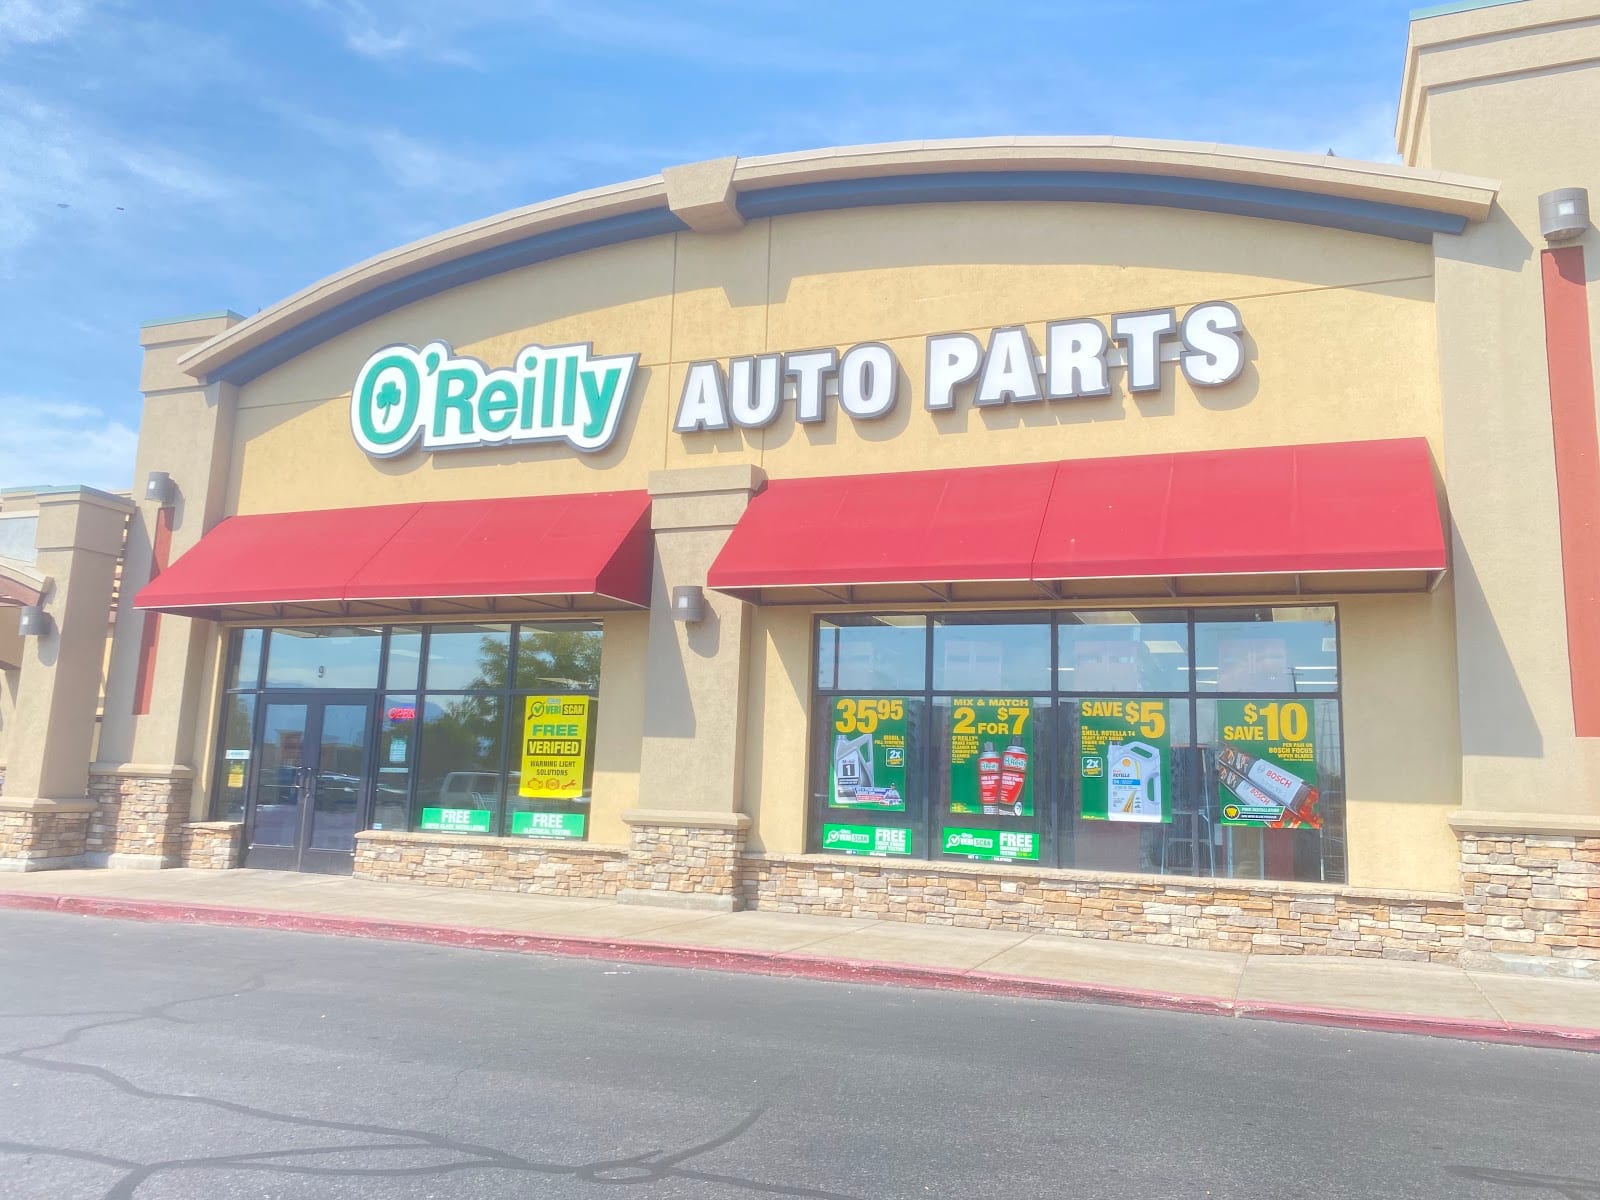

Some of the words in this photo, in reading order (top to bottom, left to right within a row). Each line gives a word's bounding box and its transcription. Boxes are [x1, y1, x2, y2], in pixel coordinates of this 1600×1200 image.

[673, 342, 897, 432] AUTO
[925, 301, 1244, 411] PARTS
[357, 350, 624, 446] O'Reilly
[563, 704, 584, 715] SCAN
[953, 707, 976, 734] 2
[978, 722, 1009, 735] FOR
[1082, 701, 1122, 717] SAVE
[1125, 701, 1166, 739] $5
[1223, 726, 1264, 740] SAVE
[1244, 702, 1308, 741] $10
[532, 724, 579, 736] FREE
[528, 740, 580, 755] VERIFIED
[1266, 770, 1292, 789] BOSCH
[442, 810, 471, 824] FREE
[533, 814, 563, 828] FREE
[875, 829, 906, 842] FREE
[1000, 833, 1032, 847] FREE
